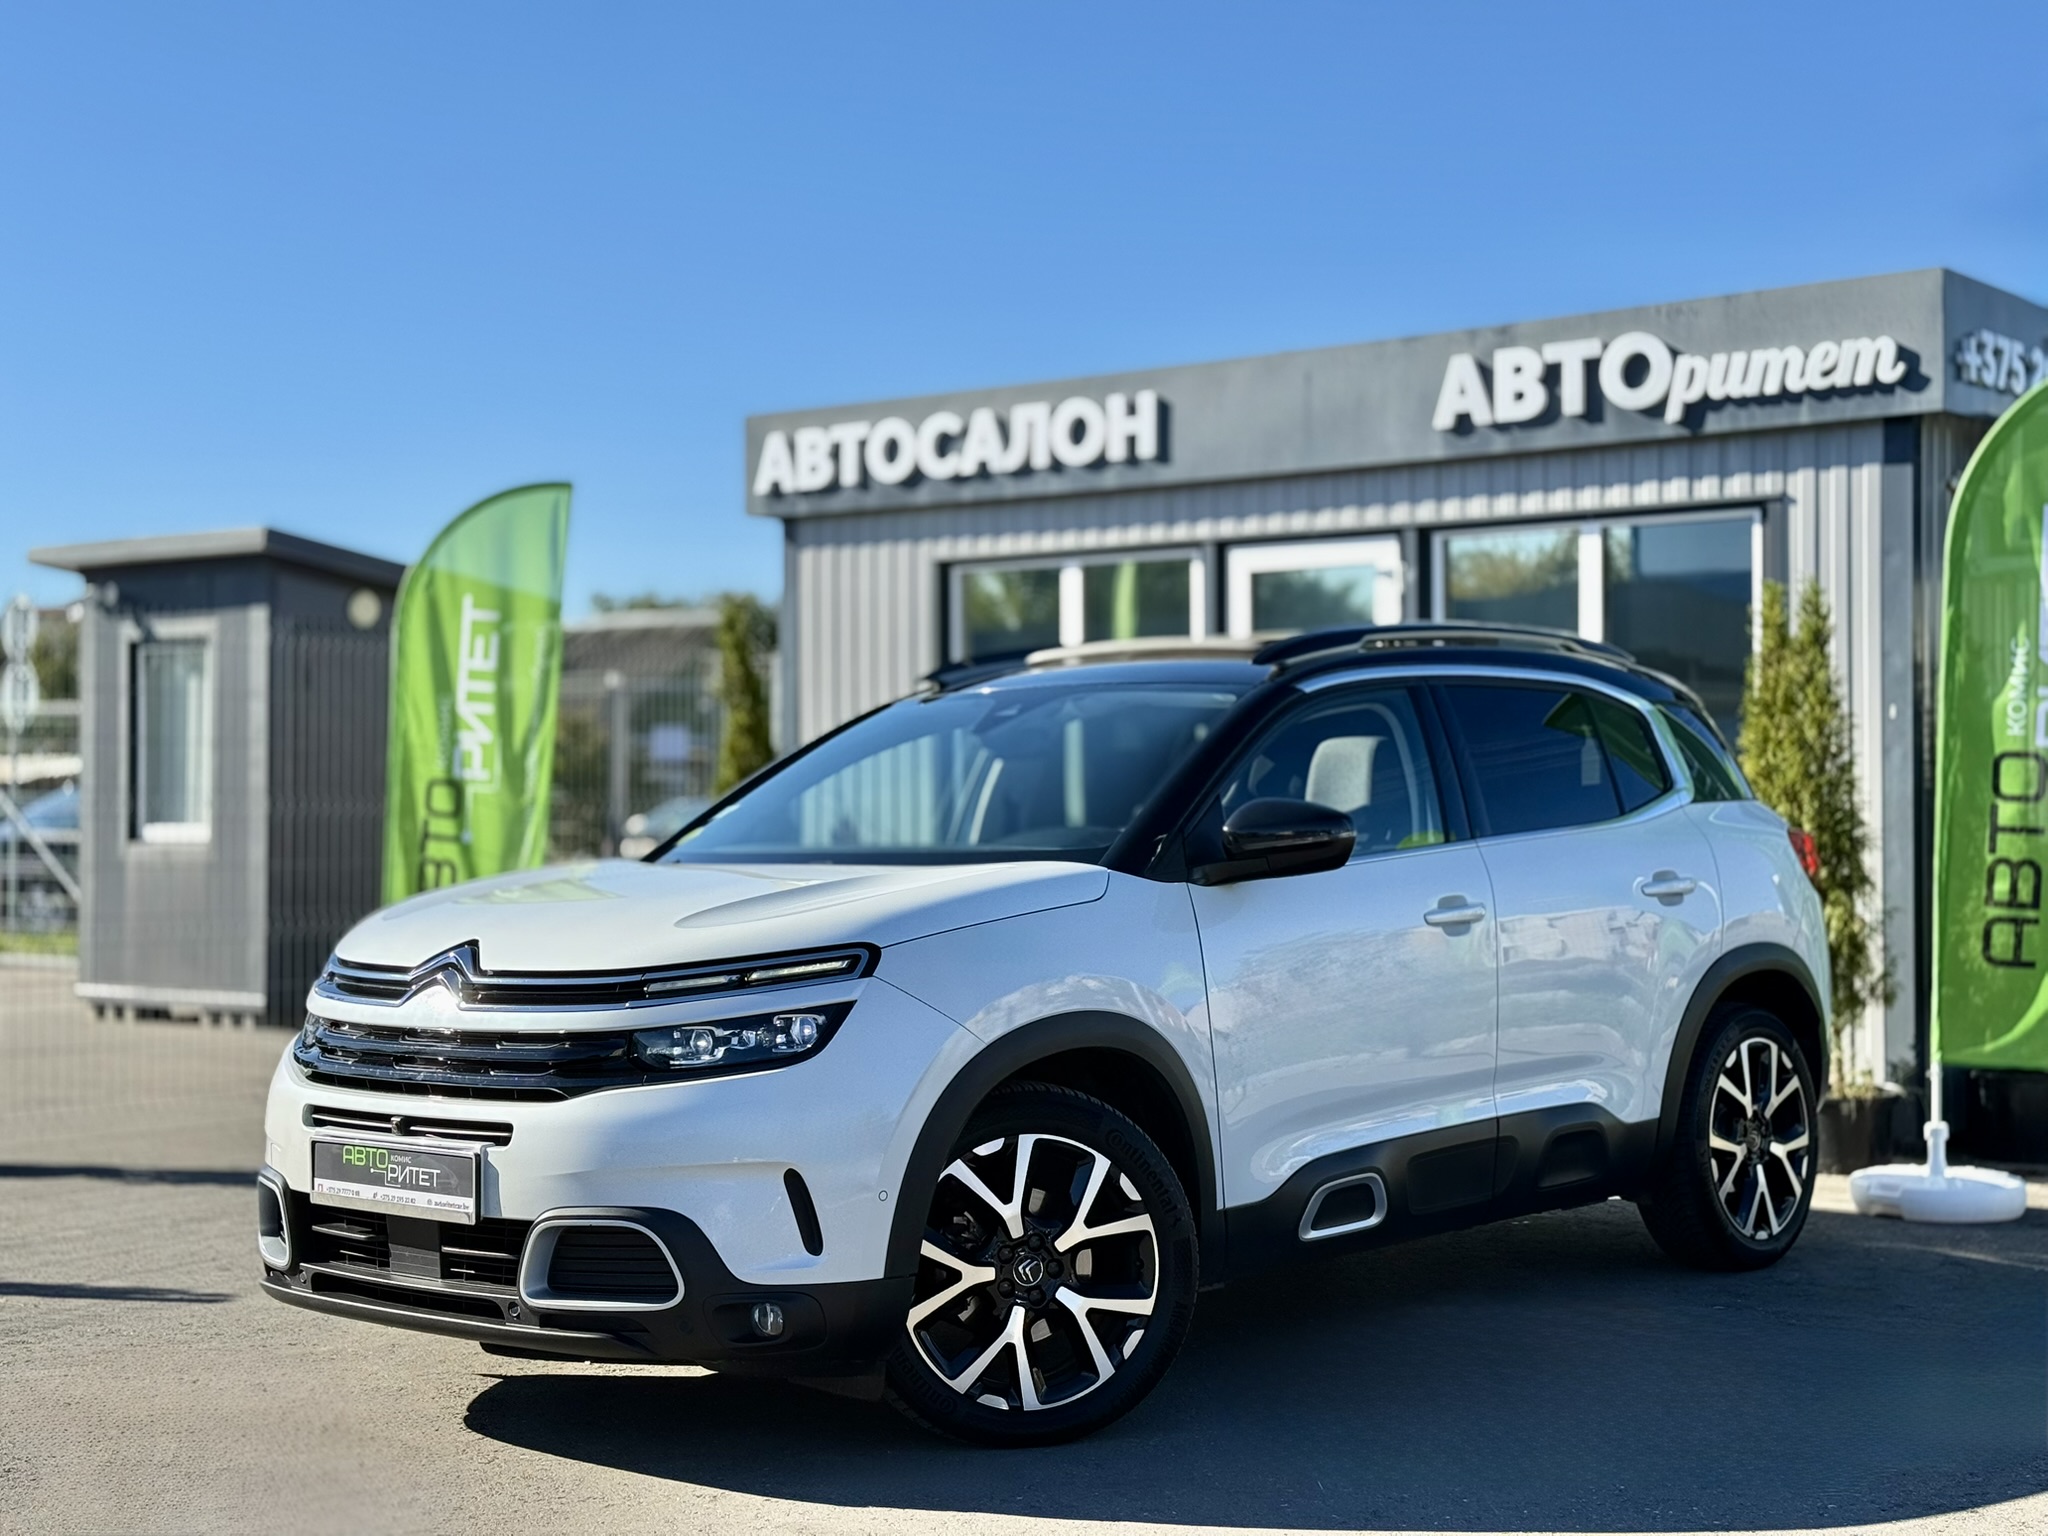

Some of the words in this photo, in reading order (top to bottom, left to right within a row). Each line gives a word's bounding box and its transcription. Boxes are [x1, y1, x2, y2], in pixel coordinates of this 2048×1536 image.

[1957, 328, 2027, 395] +375
[752, 388, 1160, 497] АВТОСАЛОН
[454, 592, 502, 782] РИТЕТ
[2006, 637, 2030, 736] КОМИС
[417, 777, 465, 893] ВТО
[1981, 751, 2048, 969] АВТО
[342, 1145, 389, 1169] АВТО
[387, 1163, 441, 1188] РИТЕТ
[390, 1154, 412, 1164] КОМИС
[1104, 1128, 1179, 1216] Continental
